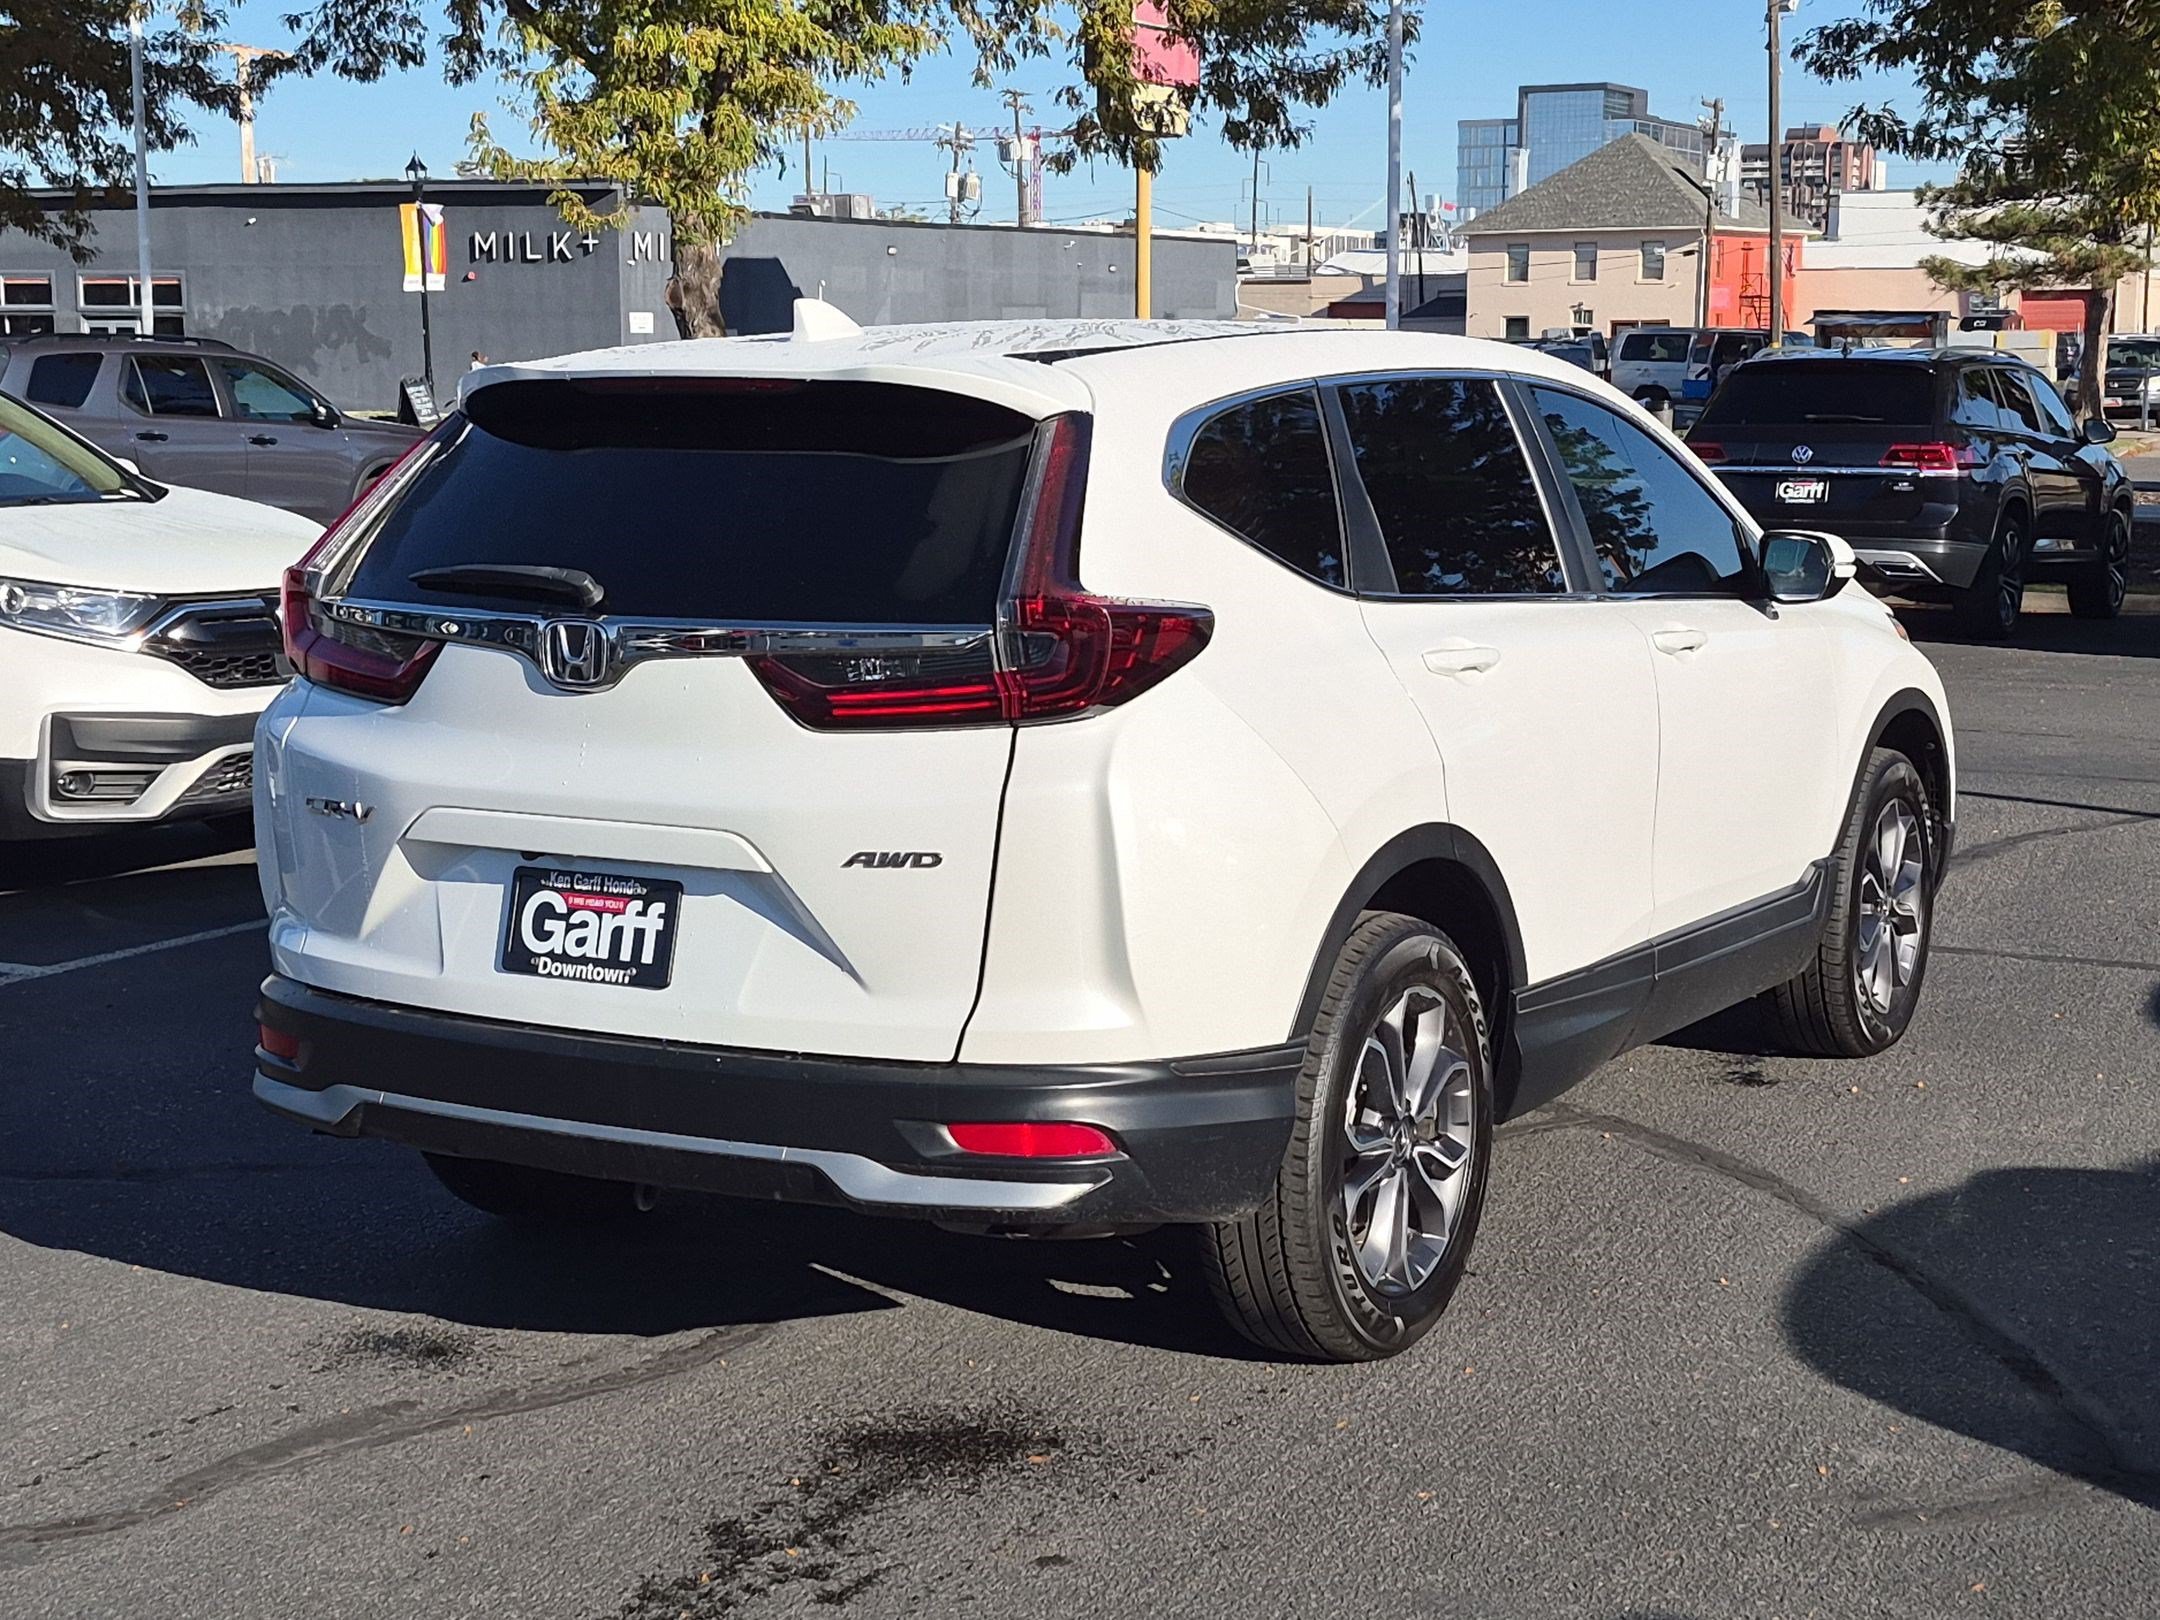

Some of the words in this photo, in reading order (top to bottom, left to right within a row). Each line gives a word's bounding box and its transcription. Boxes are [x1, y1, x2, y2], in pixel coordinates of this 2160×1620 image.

[1778, 481, 1825, 499] Garff
[840, 851, 943, 869] AWD
[550, 871, 571, 889] Ken
[573, 873, 601, 892] Garff
[603, 876, 641, 895] Honda
[521, 889, 666, 965] Garff
[538, 956, 630, 984] Downtown
